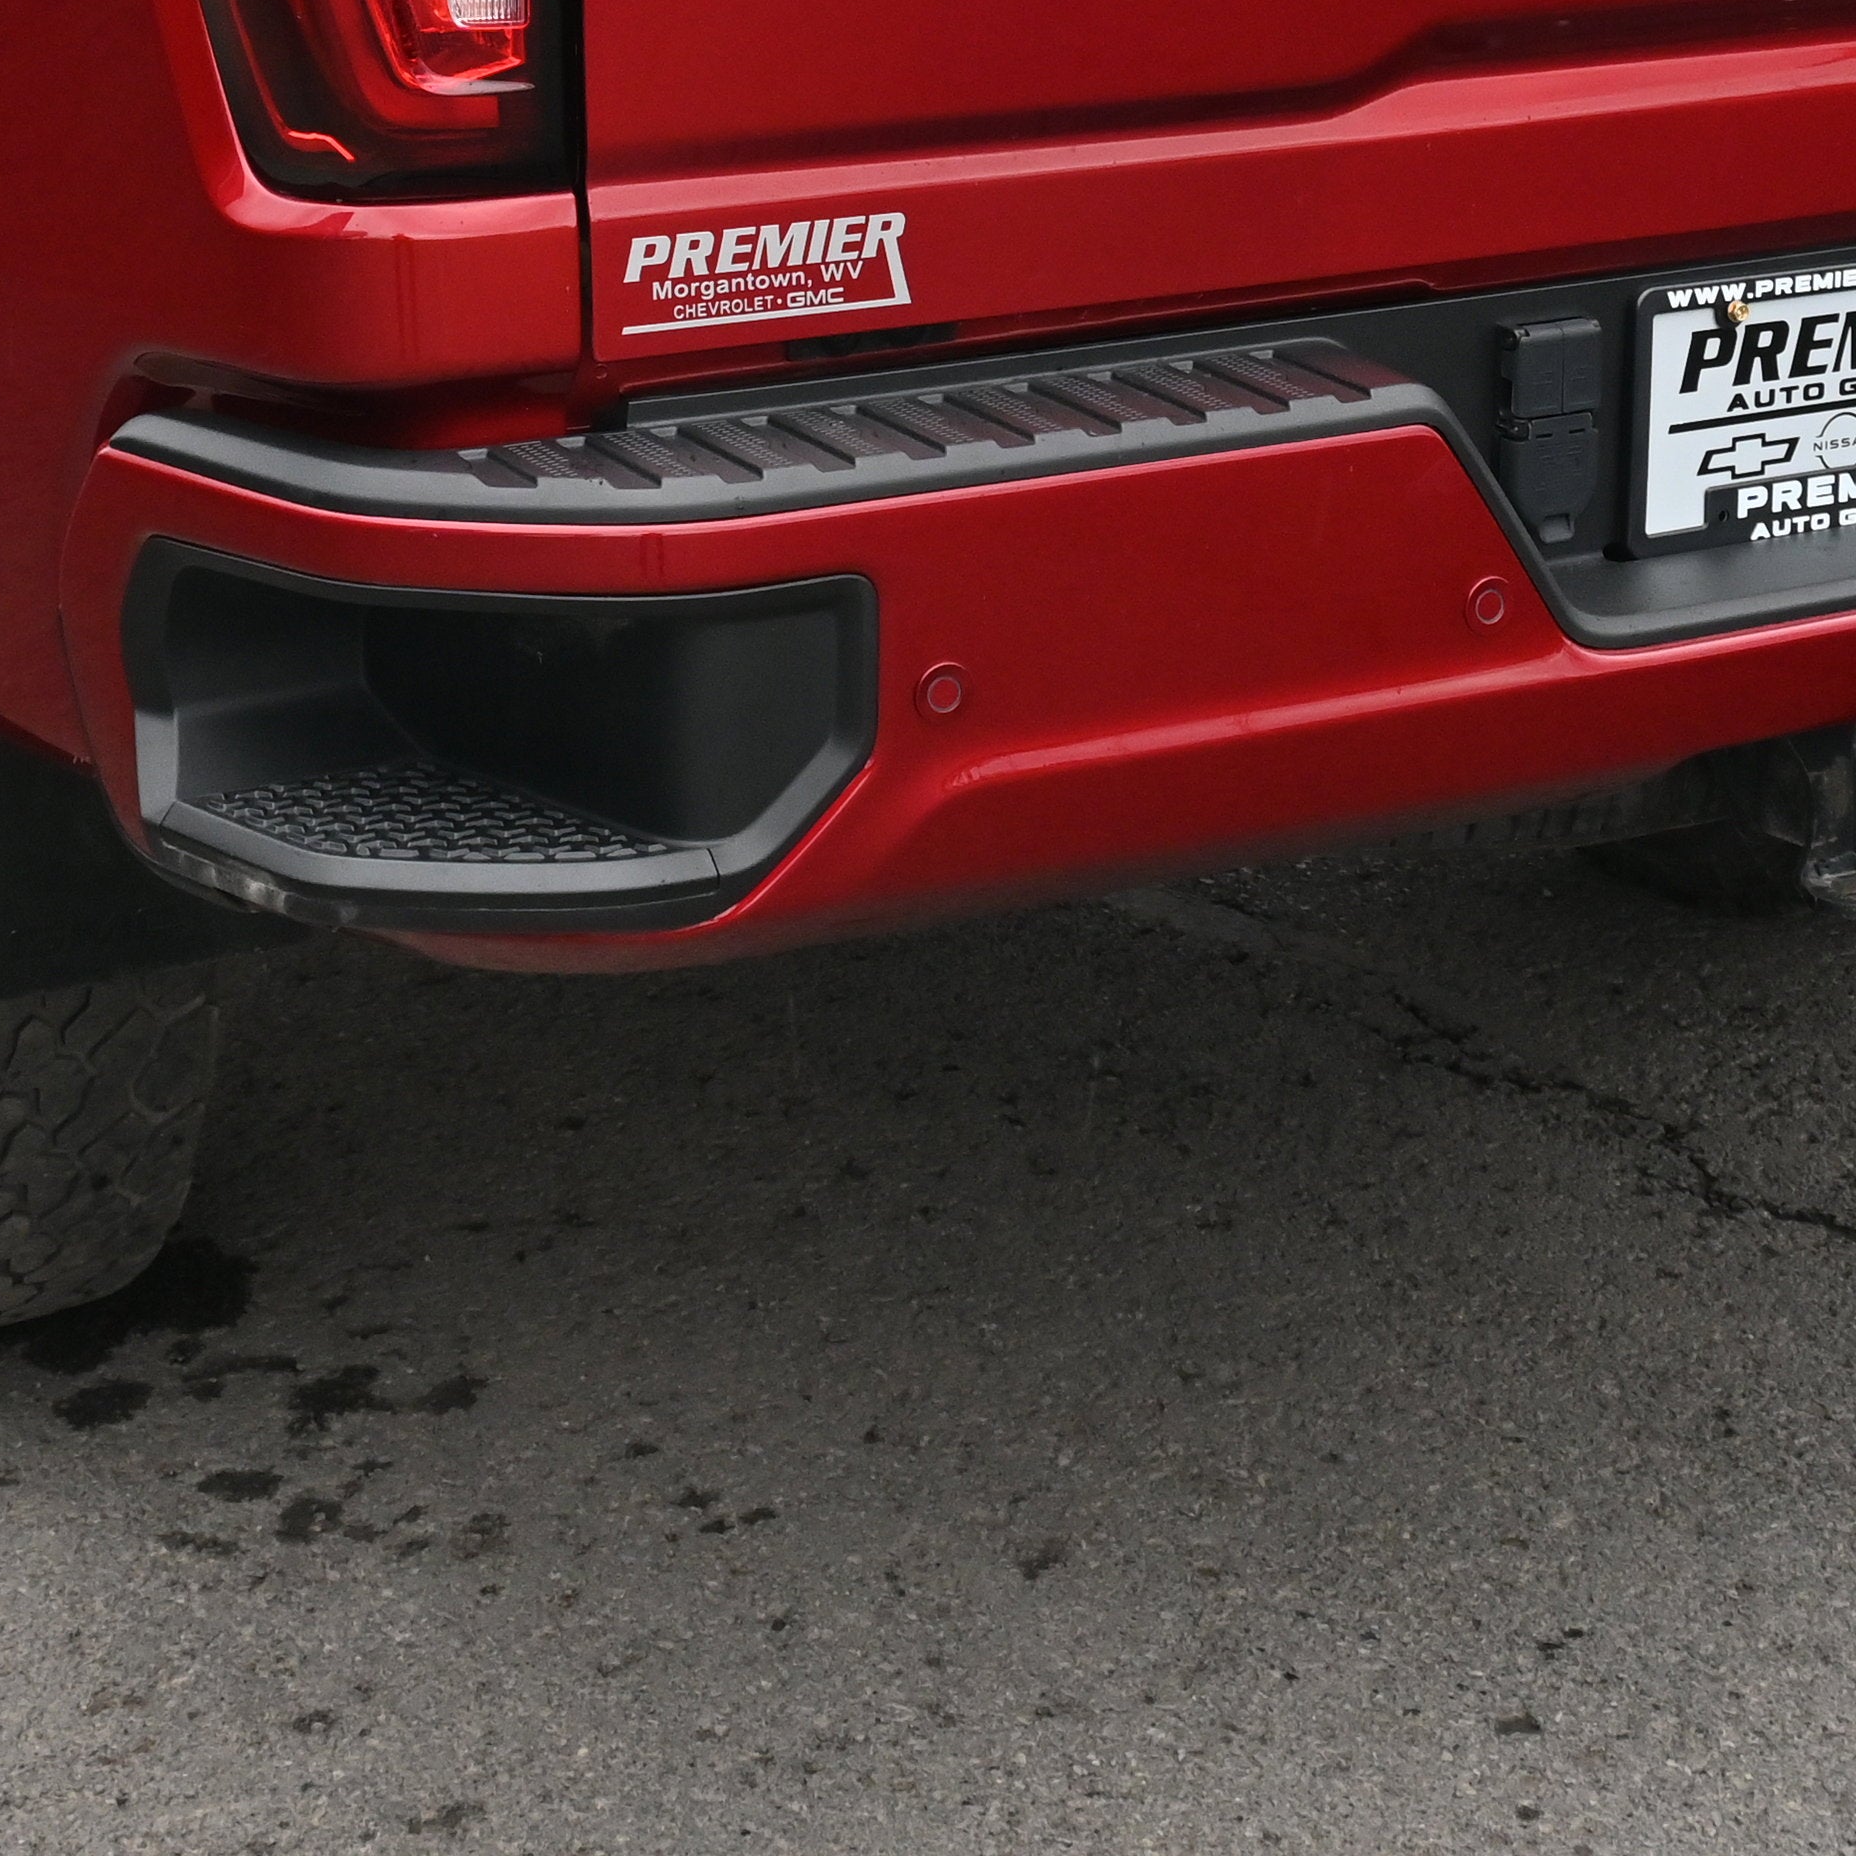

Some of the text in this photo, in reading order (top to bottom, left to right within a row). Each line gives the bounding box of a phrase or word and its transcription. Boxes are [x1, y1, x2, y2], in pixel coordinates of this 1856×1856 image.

[623, 212, 910, 286] PREMIER
[651, 260, 864, 302] Morgantown, WV
[673, 286, 845, 320] CHEVROLET GMC
[1726, 381, 1826, 413] AUTO
[1749, 511, 1832, 542] AUTO
